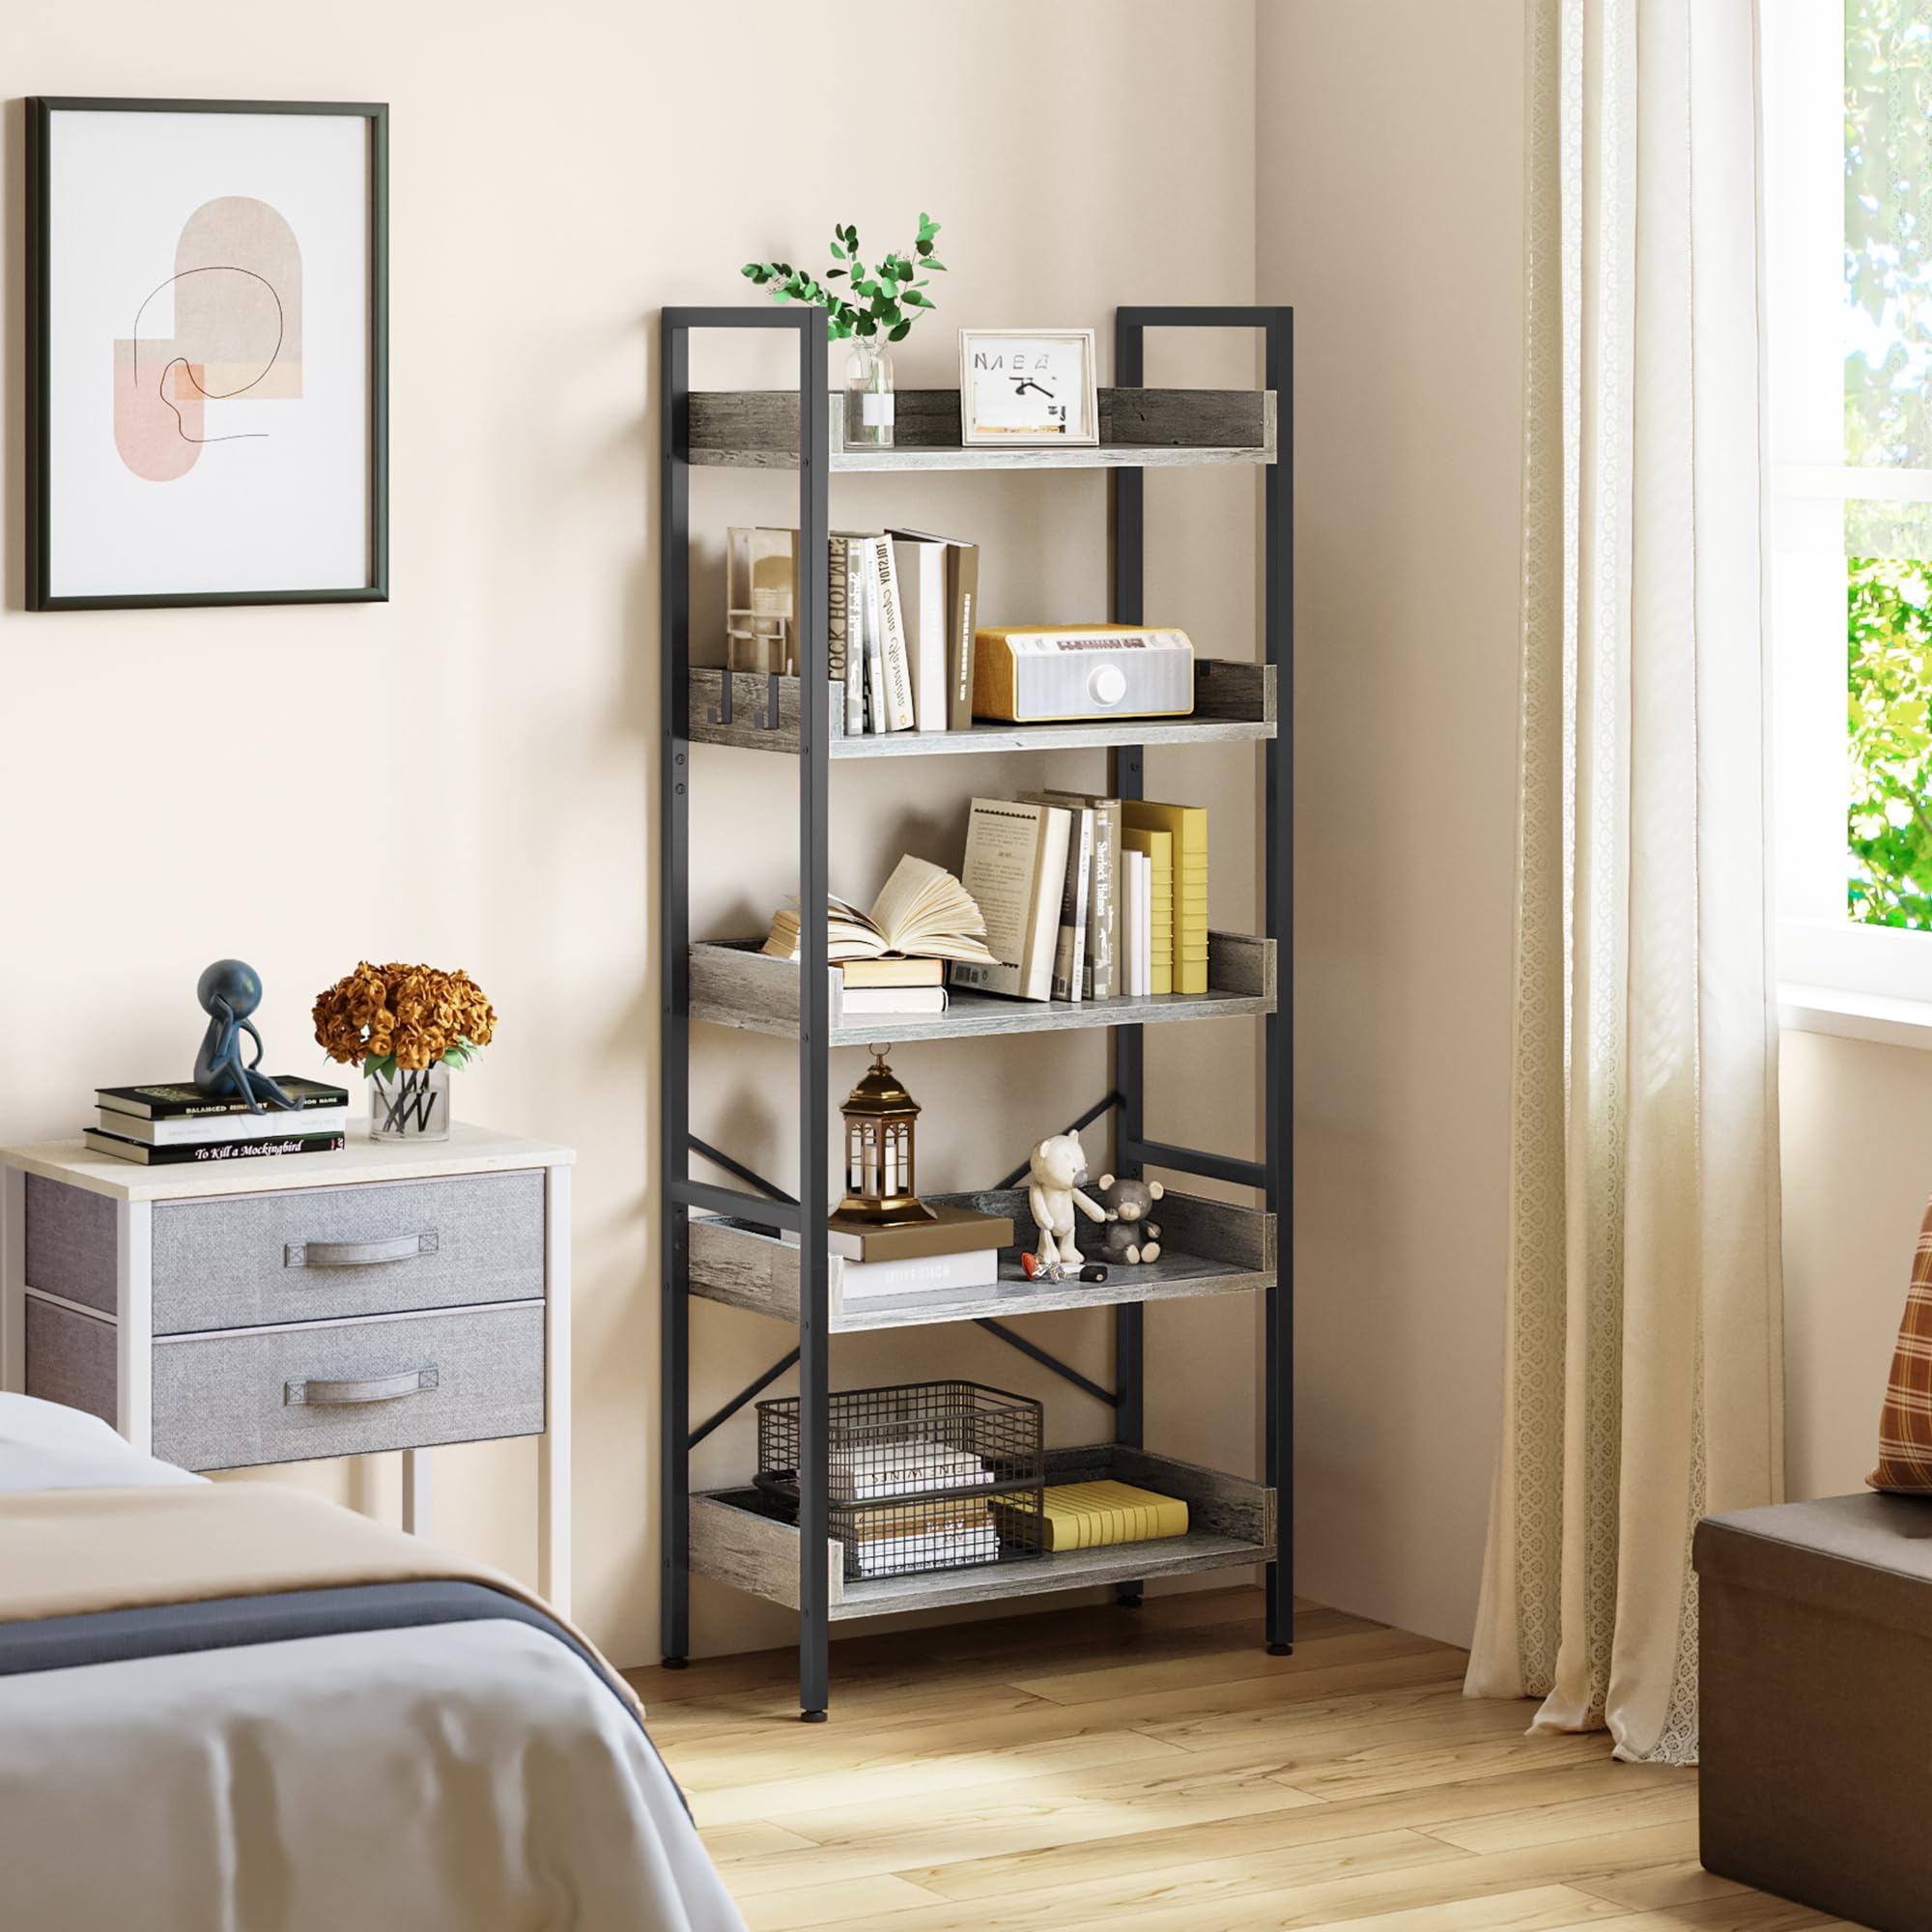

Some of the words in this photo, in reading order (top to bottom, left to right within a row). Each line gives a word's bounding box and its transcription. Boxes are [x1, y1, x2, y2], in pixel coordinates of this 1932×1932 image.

[1096, 840, 1108, 881] Sherlock
[1096, 883, 1108, 917] Holmes
[185, 1105, 227, 1114] BALANCED
[195, 1149, 209, 1160] To
[210, 1145, 232, 1160] Kill
[241, 1140, 304, 1157] Mockingbird
